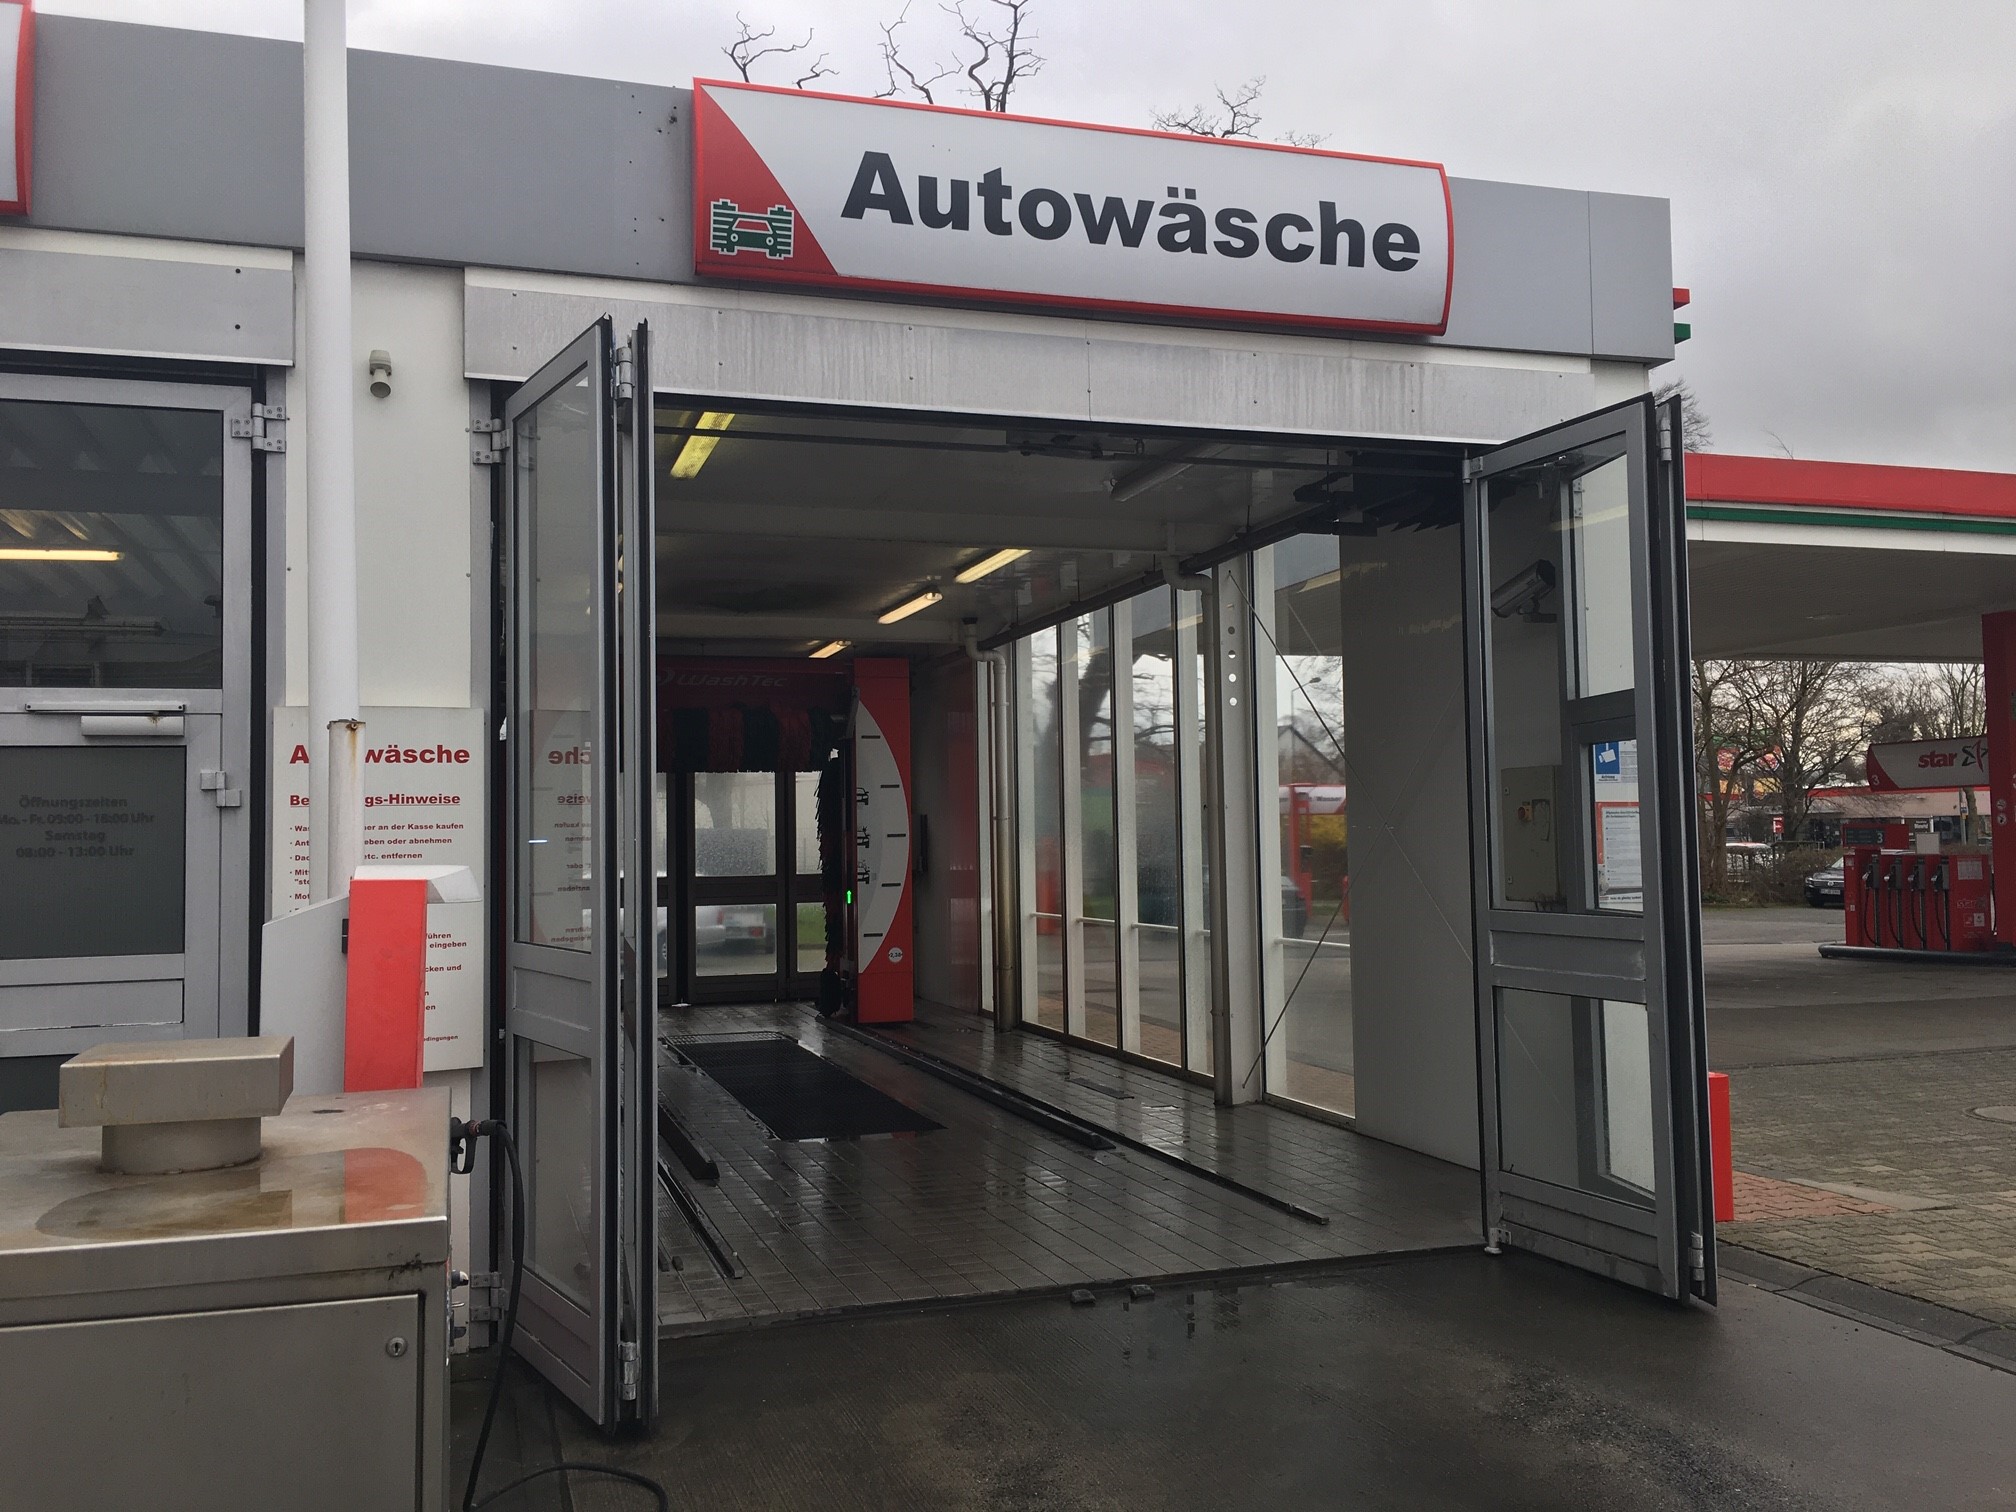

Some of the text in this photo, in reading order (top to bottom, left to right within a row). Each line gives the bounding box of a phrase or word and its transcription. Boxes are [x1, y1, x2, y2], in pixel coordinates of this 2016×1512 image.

[841, 151, 1420, 271] Autowäsche
[290, 744, 470, 764] Awäsche
[1918, 751, 1957, 768] star
[1871, 774, 1879, 785] 3
[19, 795, 128, 810] Öffnungszeiten
[290, 794, 460, 807] Begs-Hinweise
[131, 812, 155, 823] Uhr
[436, 822, 464, 830] kaufen
[45, 830, 106, 843] Samstag
[409, 836, 452, 844] abnehmen
[1877, 832, 1883, 843] 3
[16, 846, 56, 858] 08:00
[68, 846, 106, 857] 13:00
[109, 845, 135, 857] Uhr
[381, 852, 423, 860] entfernen
[429, 941, 467, 949] eingeben
